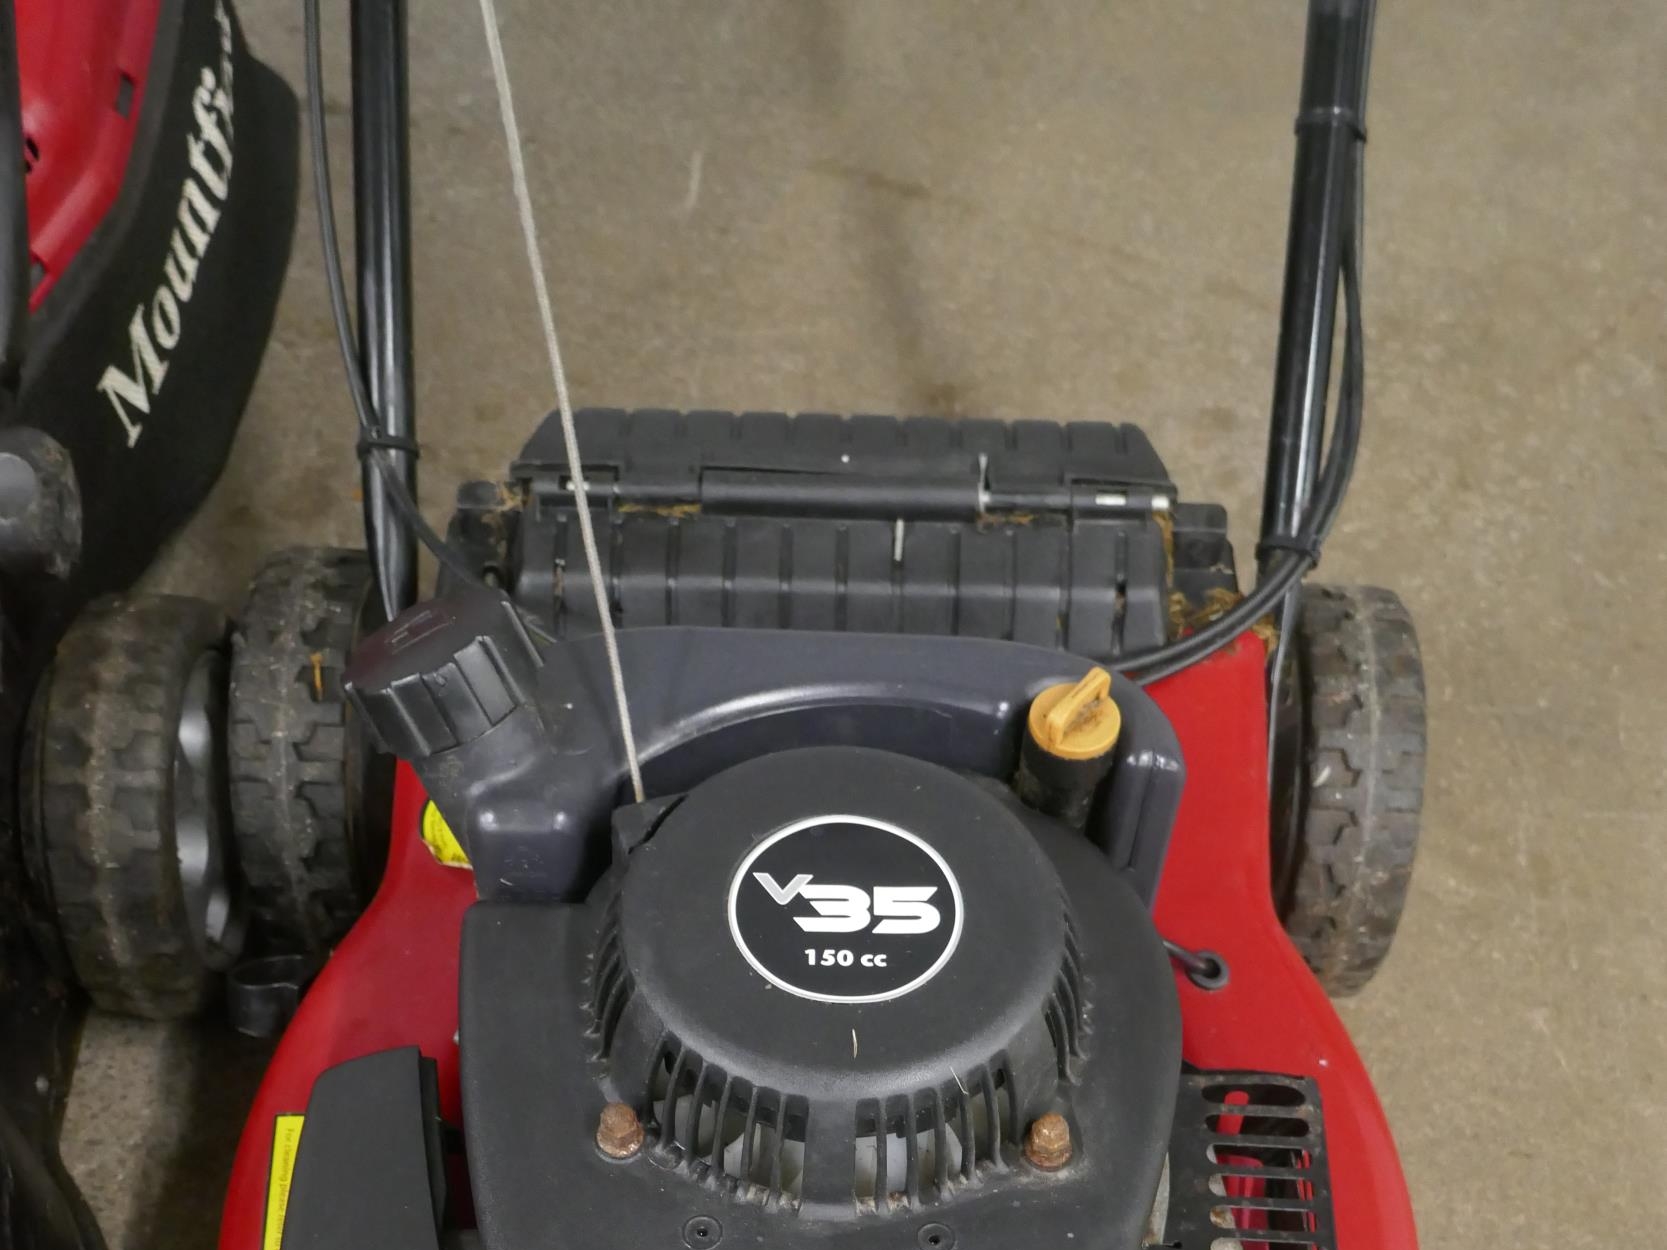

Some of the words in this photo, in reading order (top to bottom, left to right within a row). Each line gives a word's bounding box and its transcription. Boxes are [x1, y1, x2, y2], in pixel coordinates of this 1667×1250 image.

[97, 0, 234, 448] Mountfi
[804, 949, 854, 967] 150
[860, 953, 888, 967] cc
